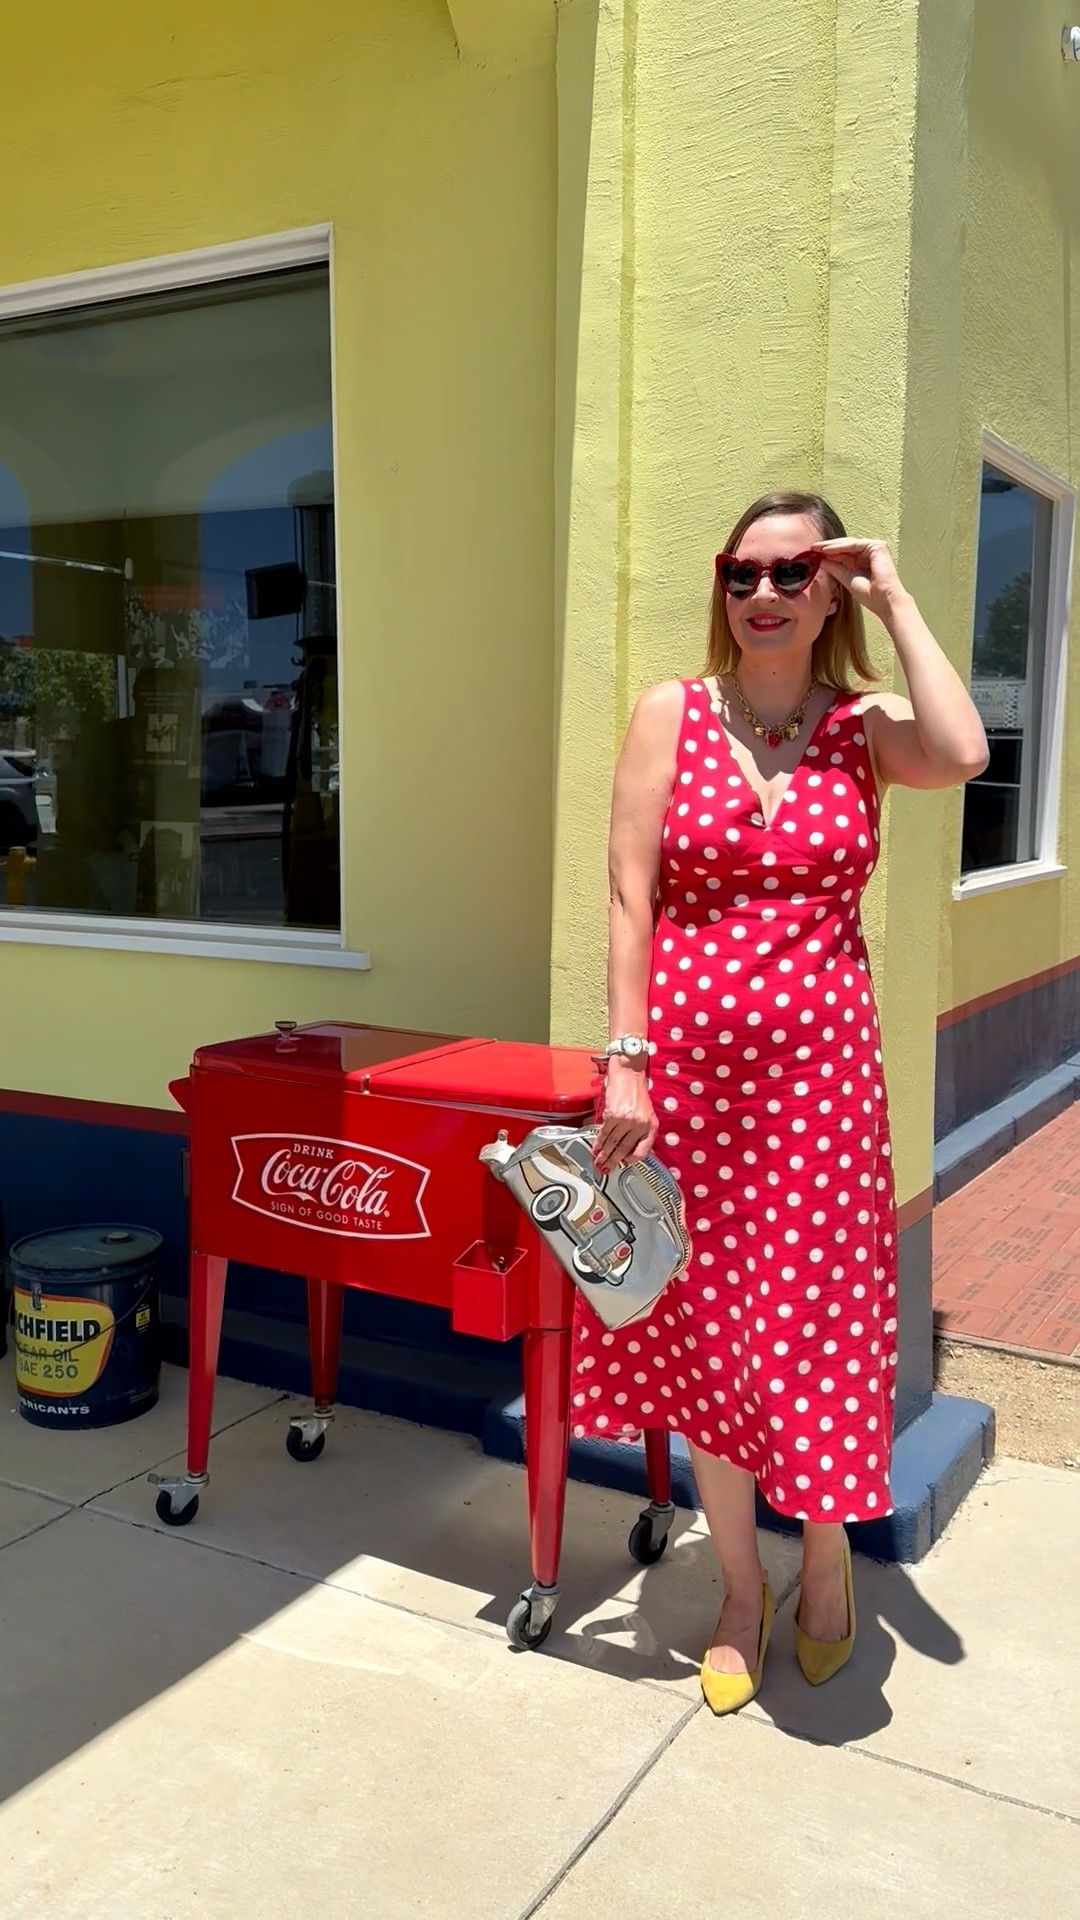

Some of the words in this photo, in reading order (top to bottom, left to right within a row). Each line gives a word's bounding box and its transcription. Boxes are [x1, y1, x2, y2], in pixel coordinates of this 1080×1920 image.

[293, 1143, 334, 1160] DRINK
[261, 1149, 395, 1217] Coca-Cola
[270, 1201, 295, 1214] SIGN
[299, 1206, 312, 1217] OF
[316, 1210, 349, 1225] GOOD
[353, 1216, 383, 1231] TASTE
[15, 1311, 101, 1342] CHFIELD
[53, 1348, 79, 1362] OIL
[43, 1364, 79, 1379] 250
[20, 1396, 90, 1415] BRICANTS
